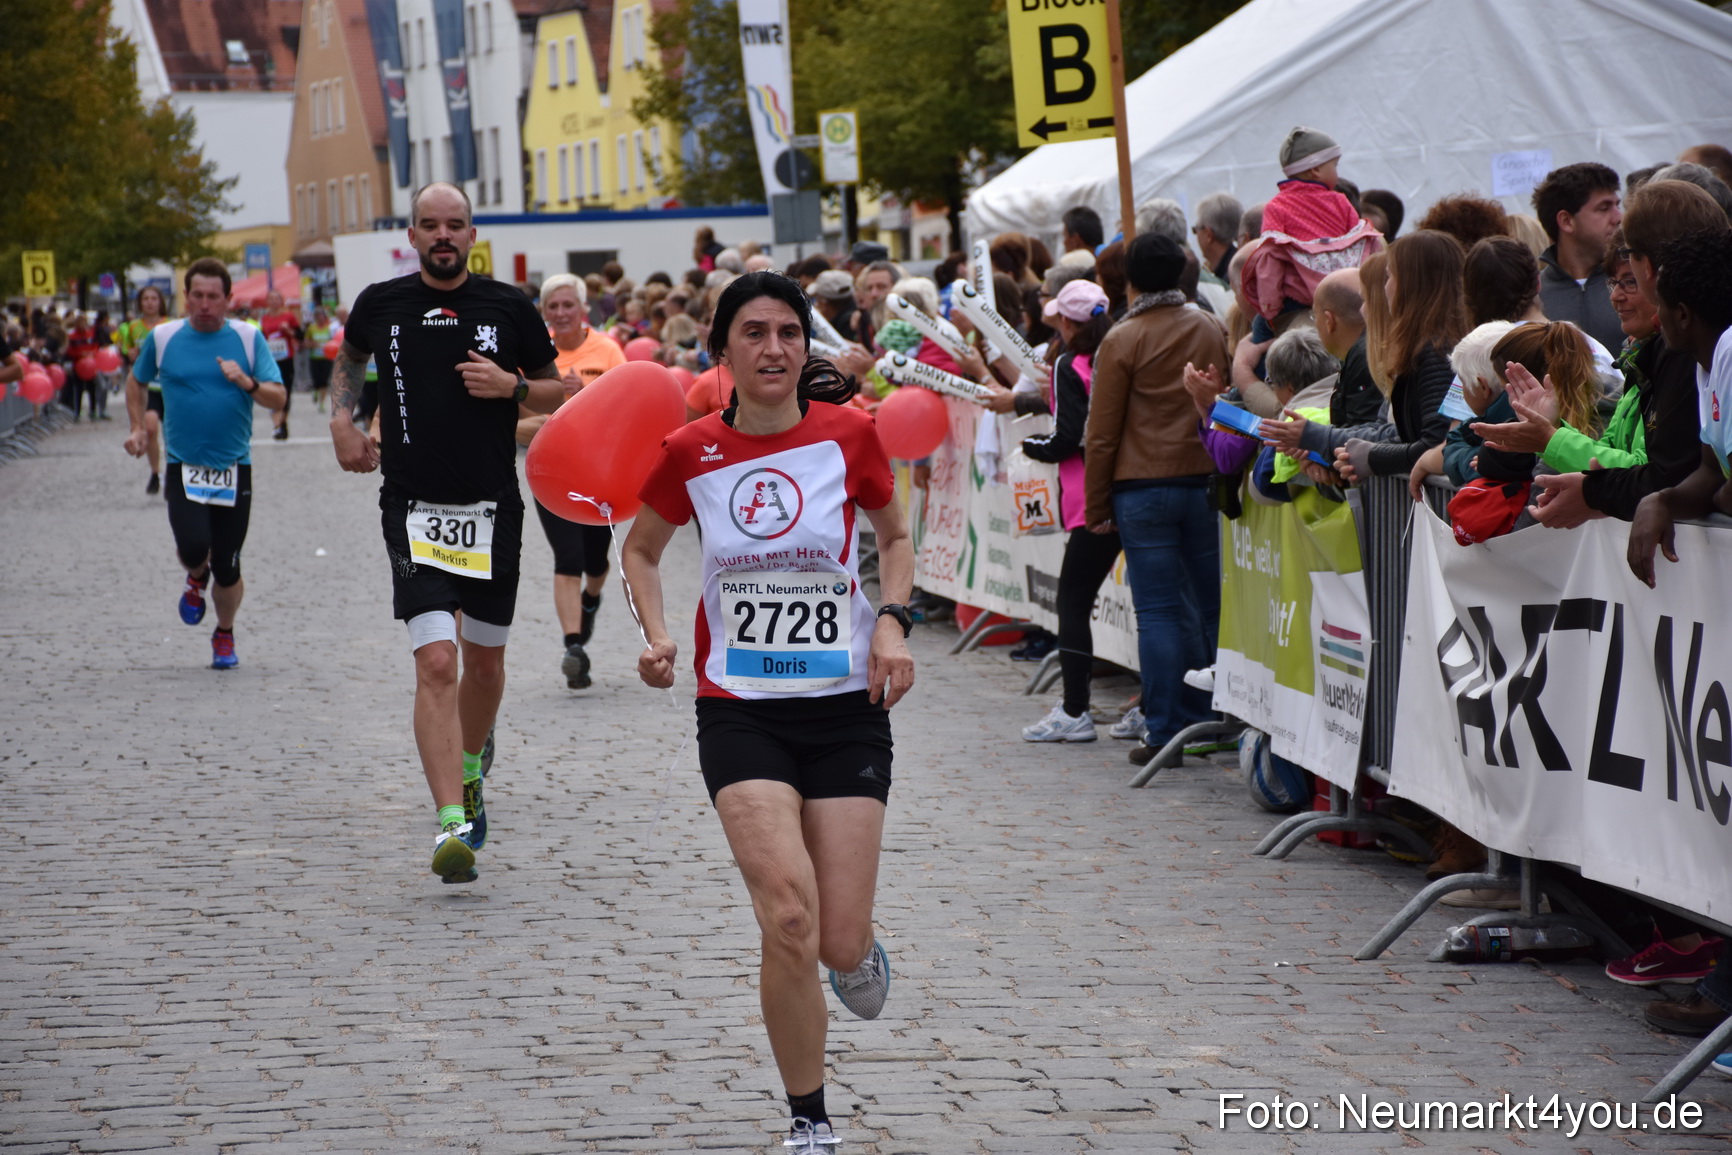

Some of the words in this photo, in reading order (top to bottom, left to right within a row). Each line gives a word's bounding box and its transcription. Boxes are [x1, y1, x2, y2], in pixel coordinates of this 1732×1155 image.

[1039, 23, 1096, 107] B
[31, 265, 47, 288] D
[422, 318, 459, 326] skinfit
[914, 362, 946, 383] BMW
[389, 325, 411, 444] BAVARTRIA
[701, 453, 724, 462] erima
[189, 468, 232, 487] 2420
[442, 508, 480, 518] Neumarkt
[1025, 500, 1043, 519] M
[424, 516, 476, 548] 330
[432, 547, 468, 567] Markus
[767, 551, 790, 561] MIT
[722, 583, 763, 594] PARTL
[766, 583, 828, 595] Neumarkt
[734, 600, 839, 644] 2728
[763, 656, 807, 674] Doris
